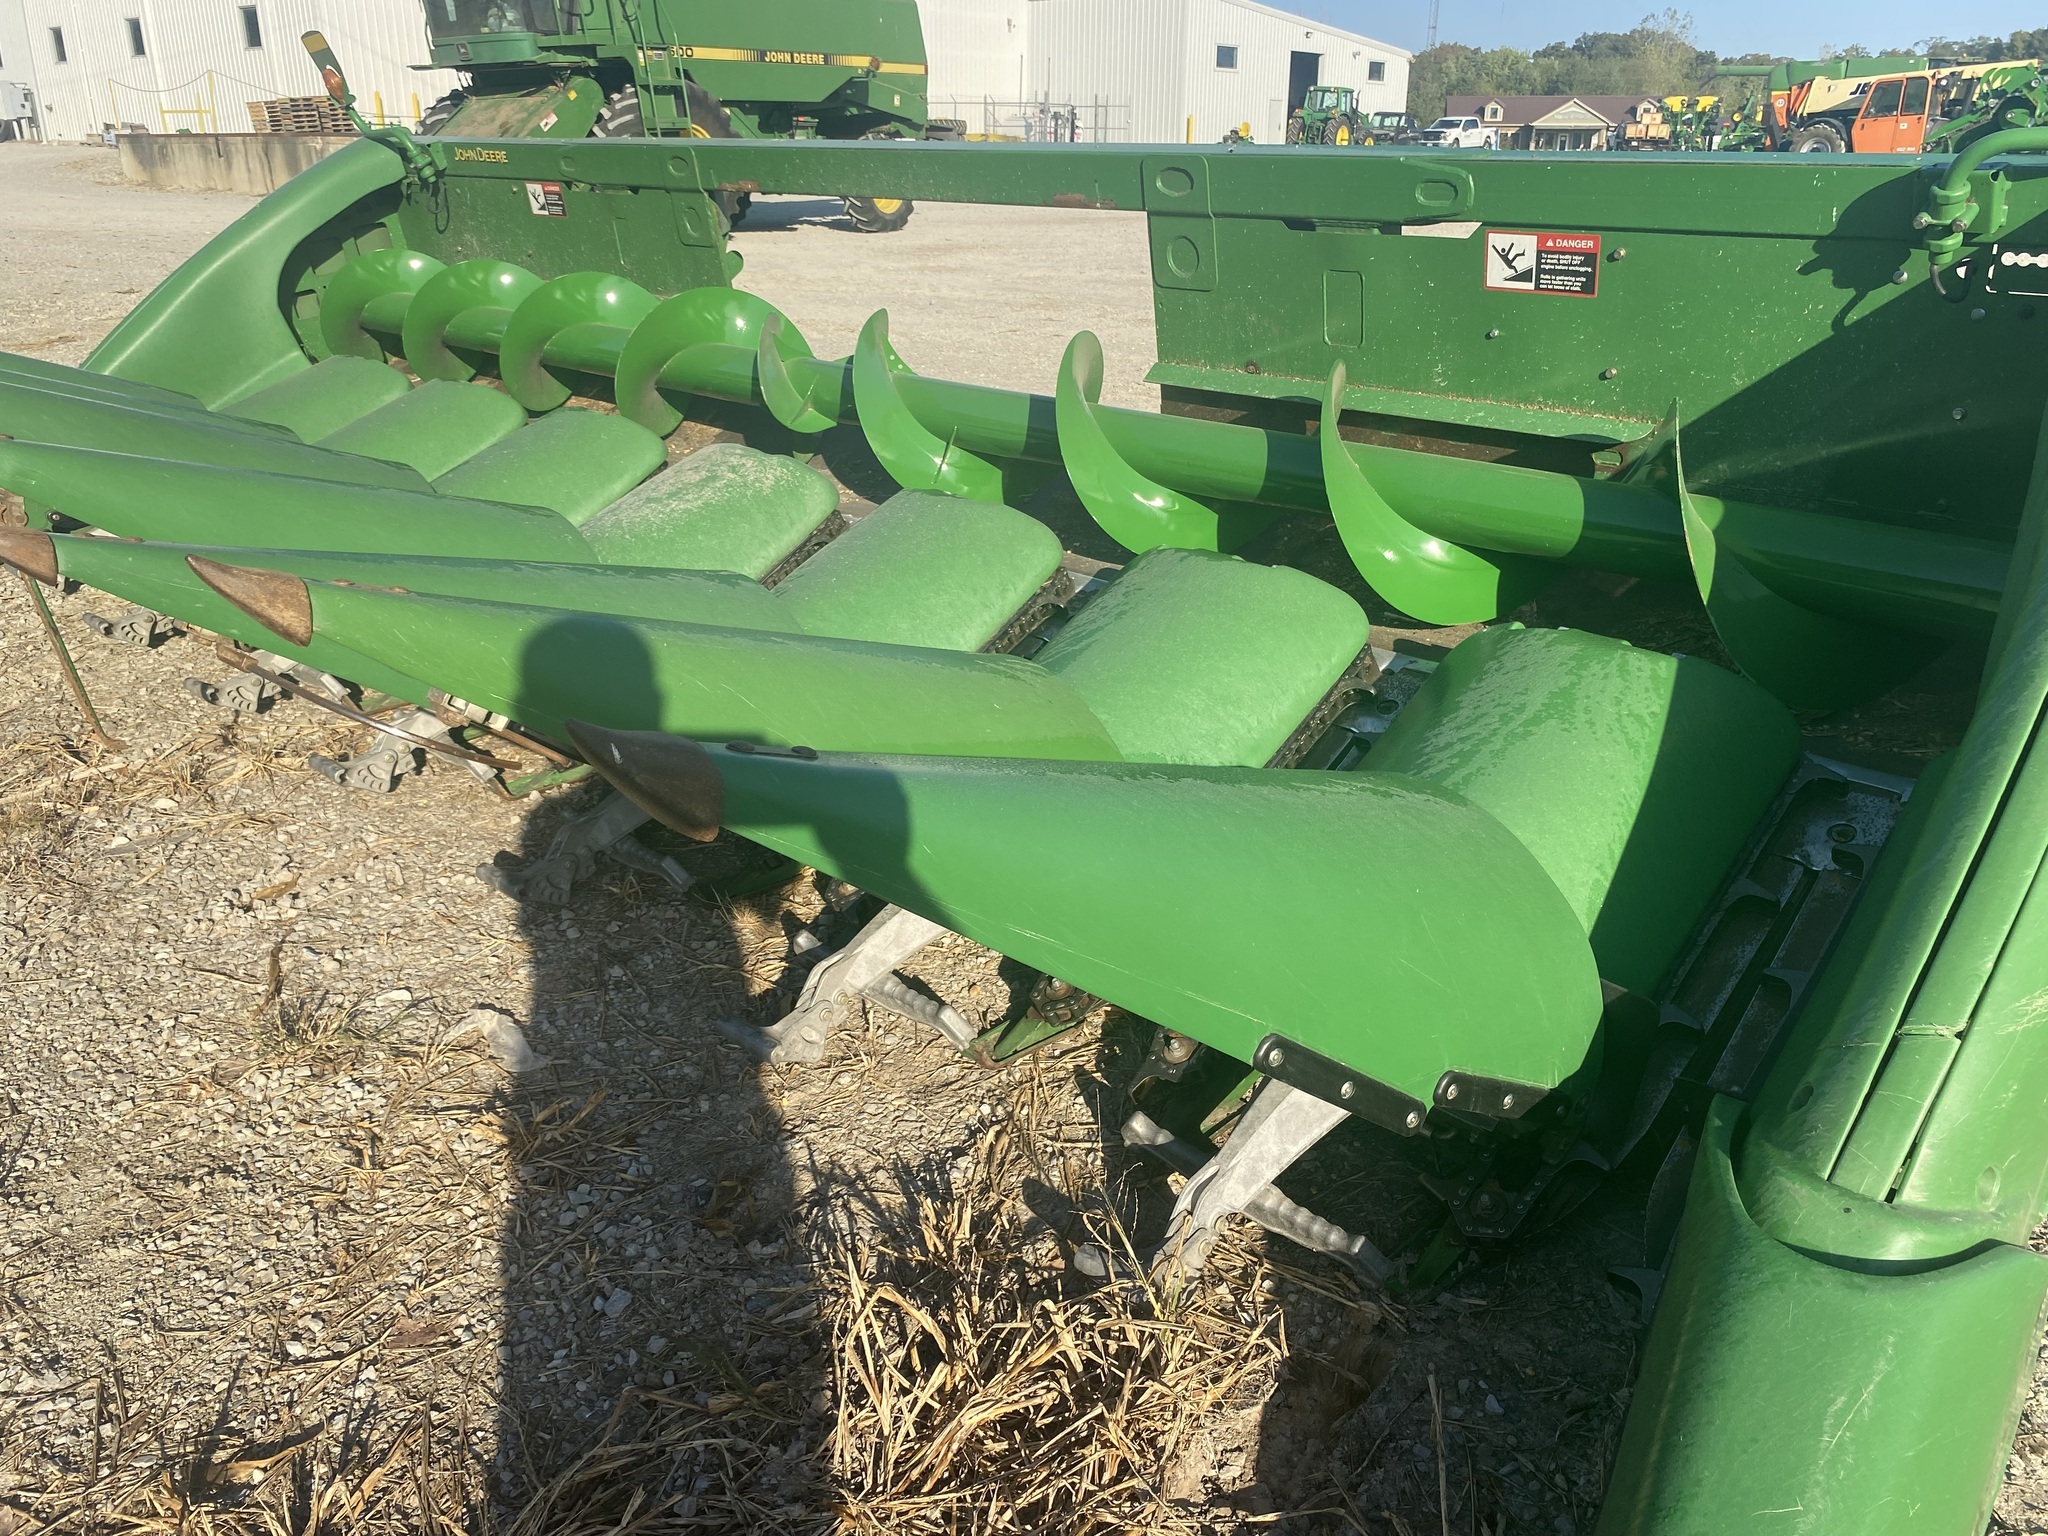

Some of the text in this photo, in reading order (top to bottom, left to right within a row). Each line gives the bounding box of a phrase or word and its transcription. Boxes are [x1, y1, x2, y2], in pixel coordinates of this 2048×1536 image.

[765, 51, 824, 65] JOHN DEERE
[455, 146, 509, 163] JOHN DEERE
[1556, 238, 1594, 249] DANGER
